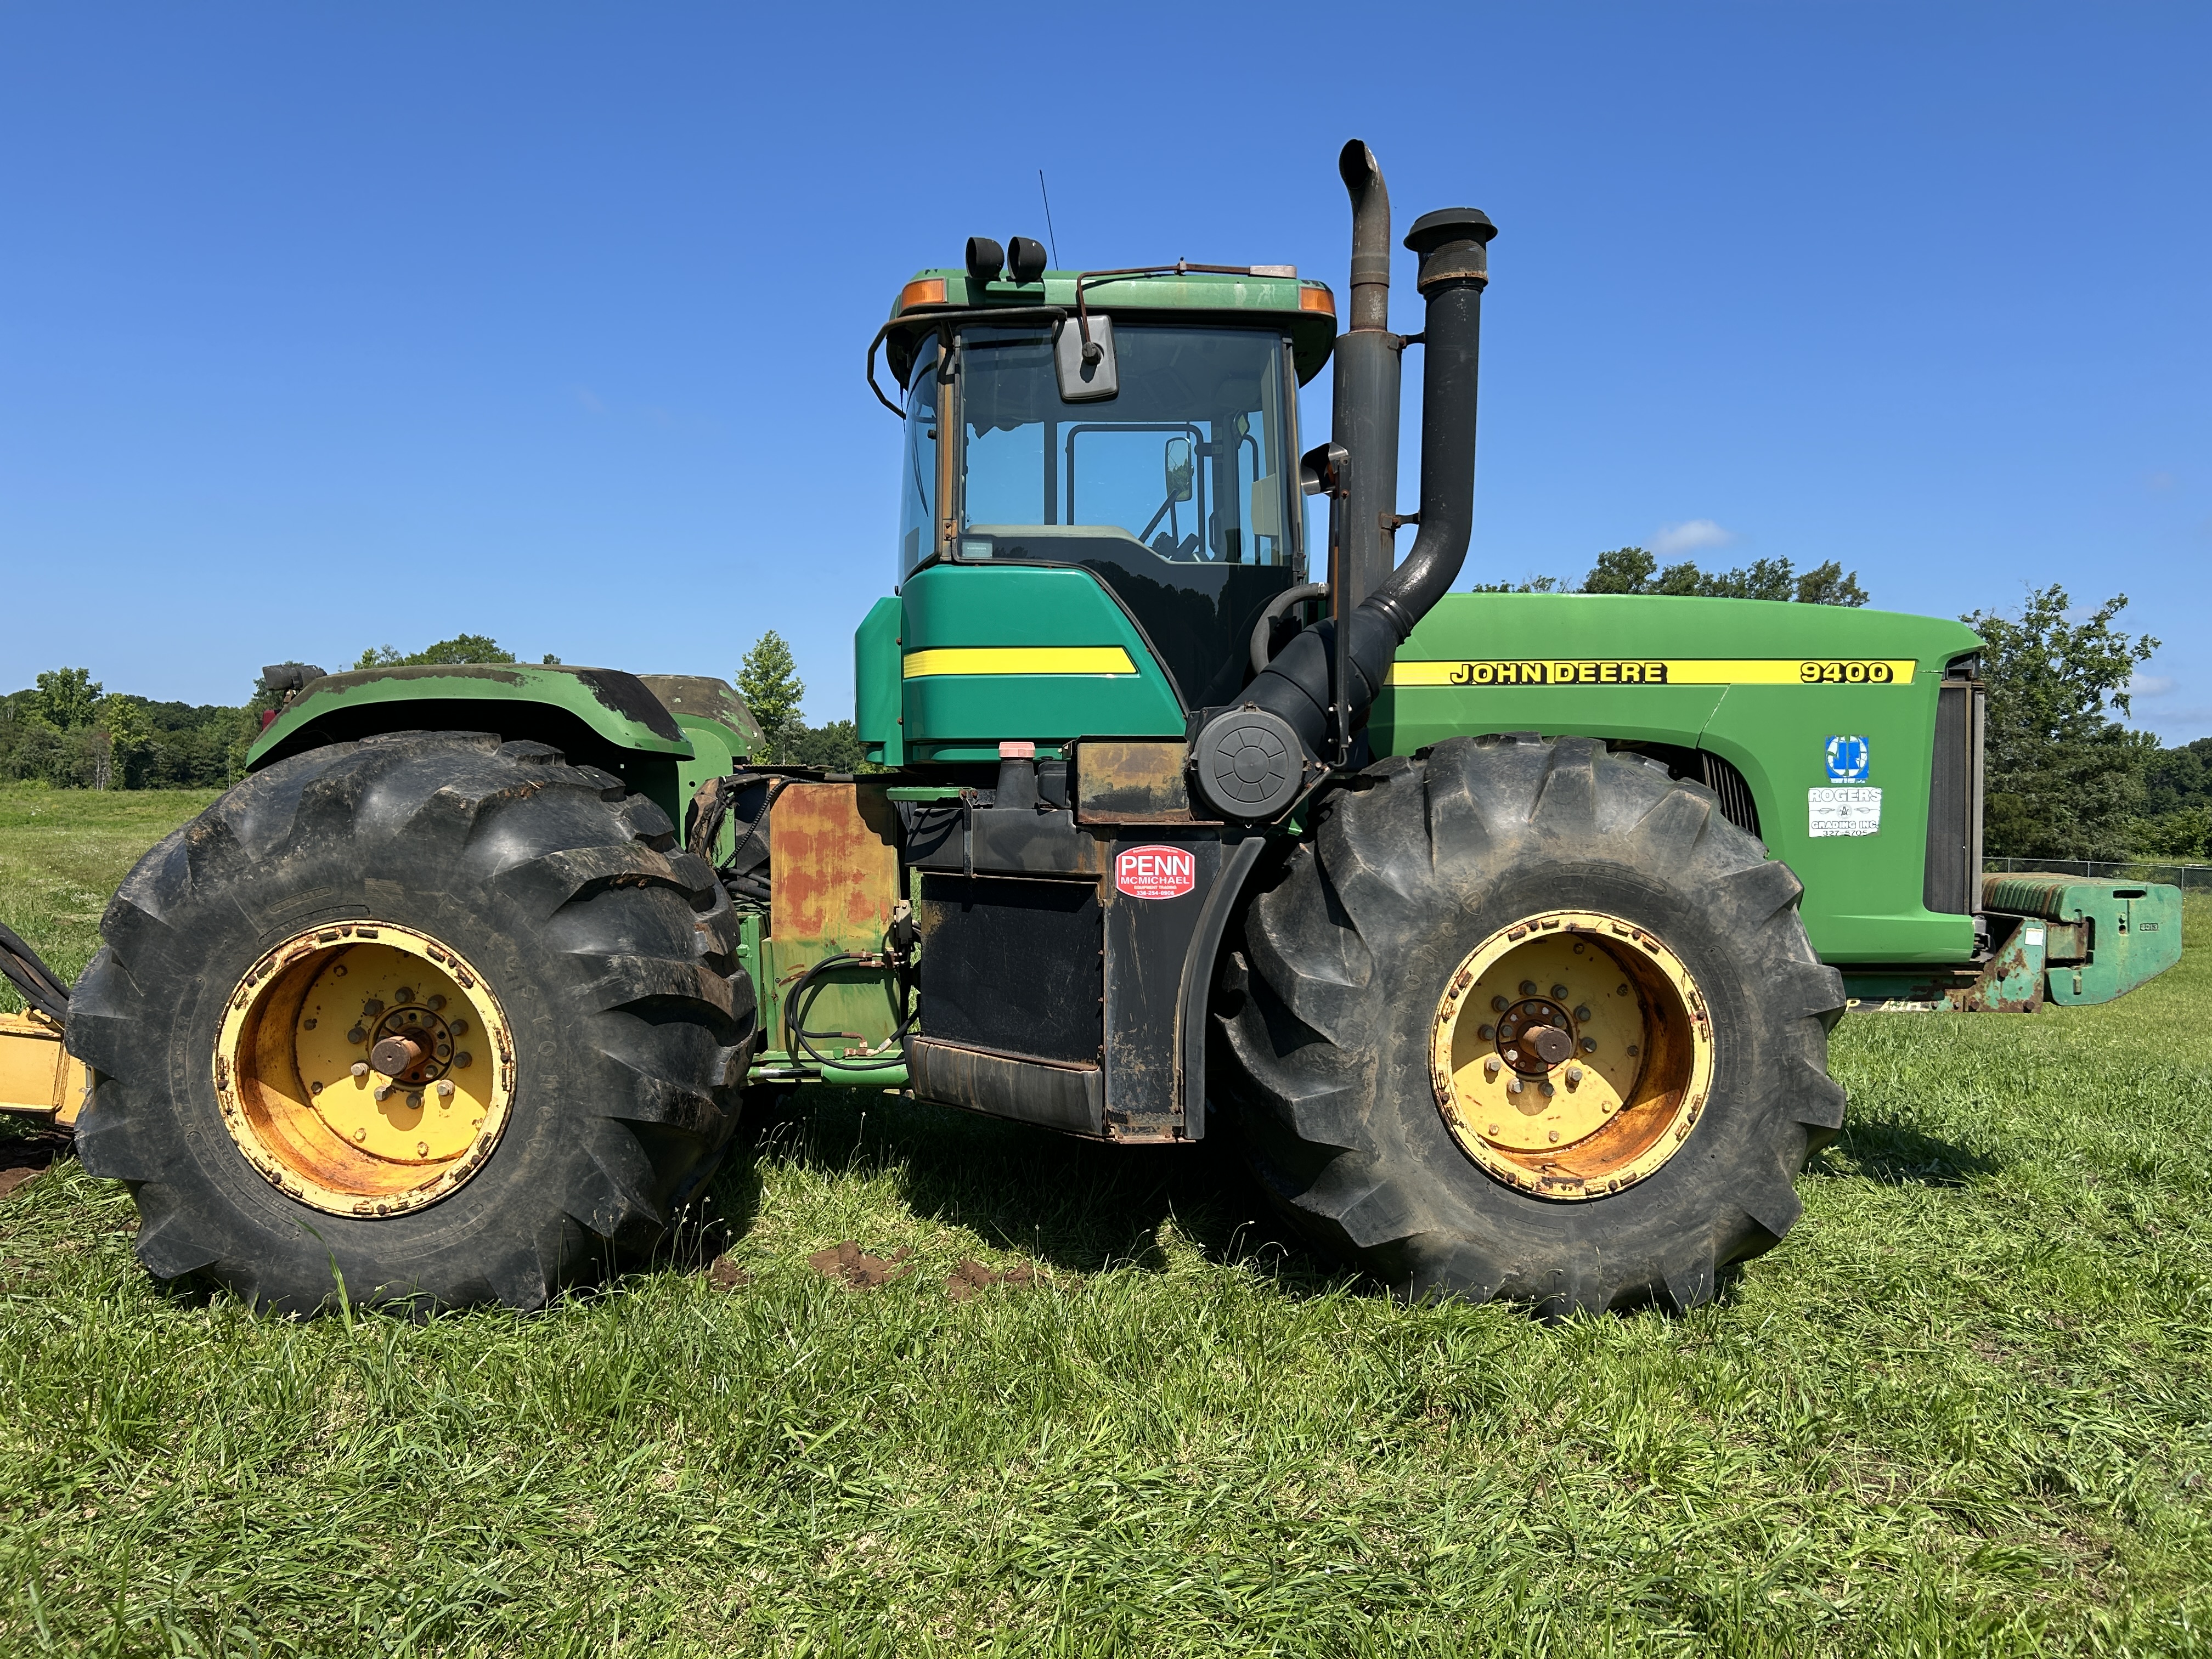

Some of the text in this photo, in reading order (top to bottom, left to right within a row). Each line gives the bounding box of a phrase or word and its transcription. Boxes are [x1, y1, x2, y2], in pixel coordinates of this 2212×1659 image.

[1451, 663, 1667, 684] JOHN DEERE
[1801, 662, 1893, 683] 9400
[1809, 788, 1882, 802] ROGERS
[1812, 821, 1856, 829] GRADING
[1121, 856, 1189, 876] PENN
